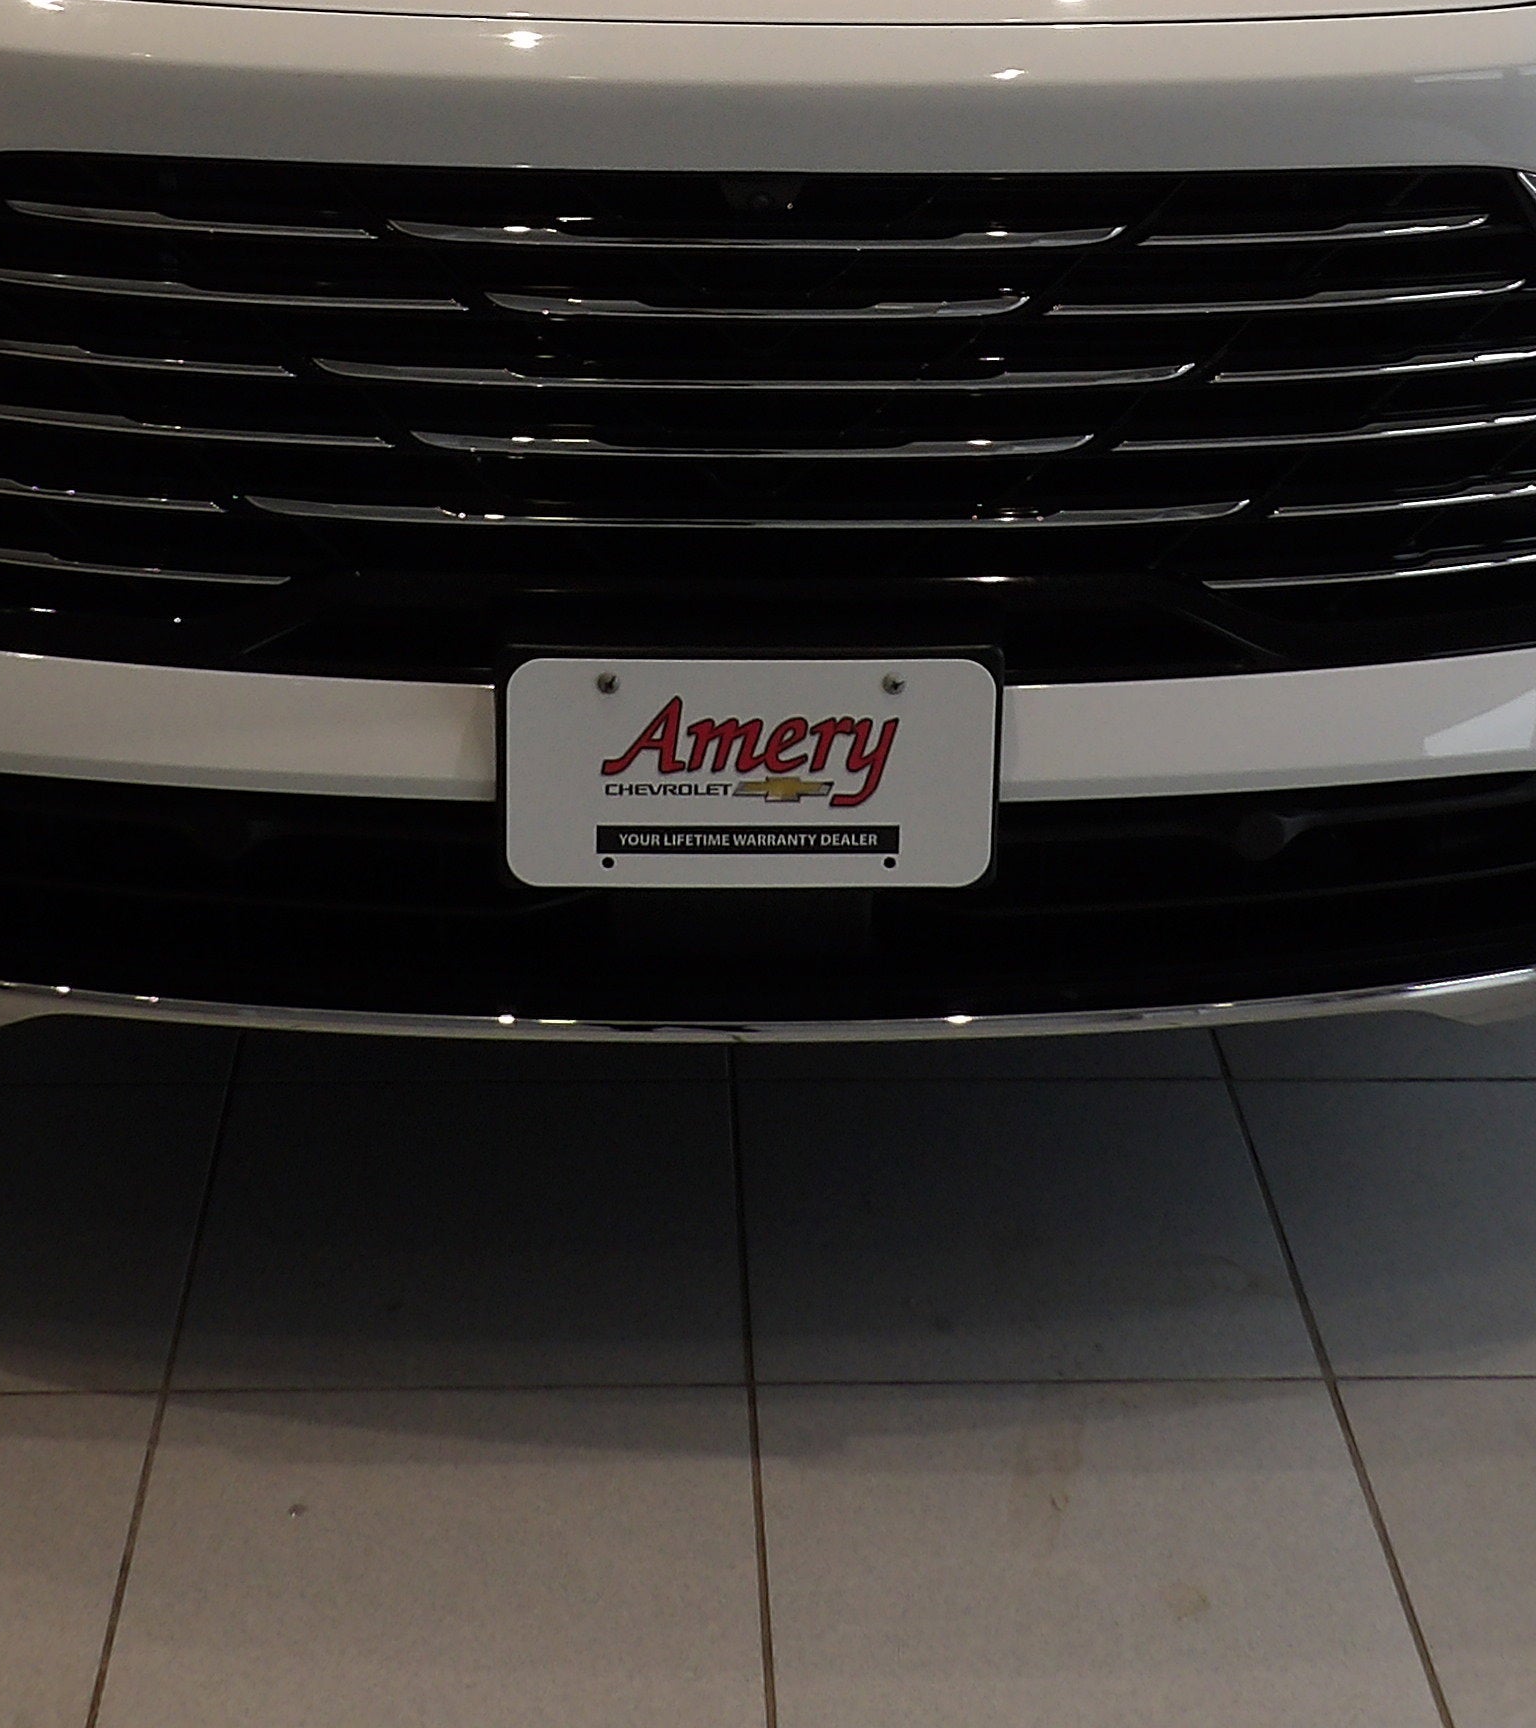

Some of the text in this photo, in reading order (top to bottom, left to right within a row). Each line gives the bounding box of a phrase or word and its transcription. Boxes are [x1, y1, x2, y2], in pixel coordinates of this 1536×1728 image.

[601, 695, 900, 807] Amery
[604, 783, 732, 797] CHEVROLET
[619, 833, 878, 847] YOUR LIFETIME WARRANTY DEALER
